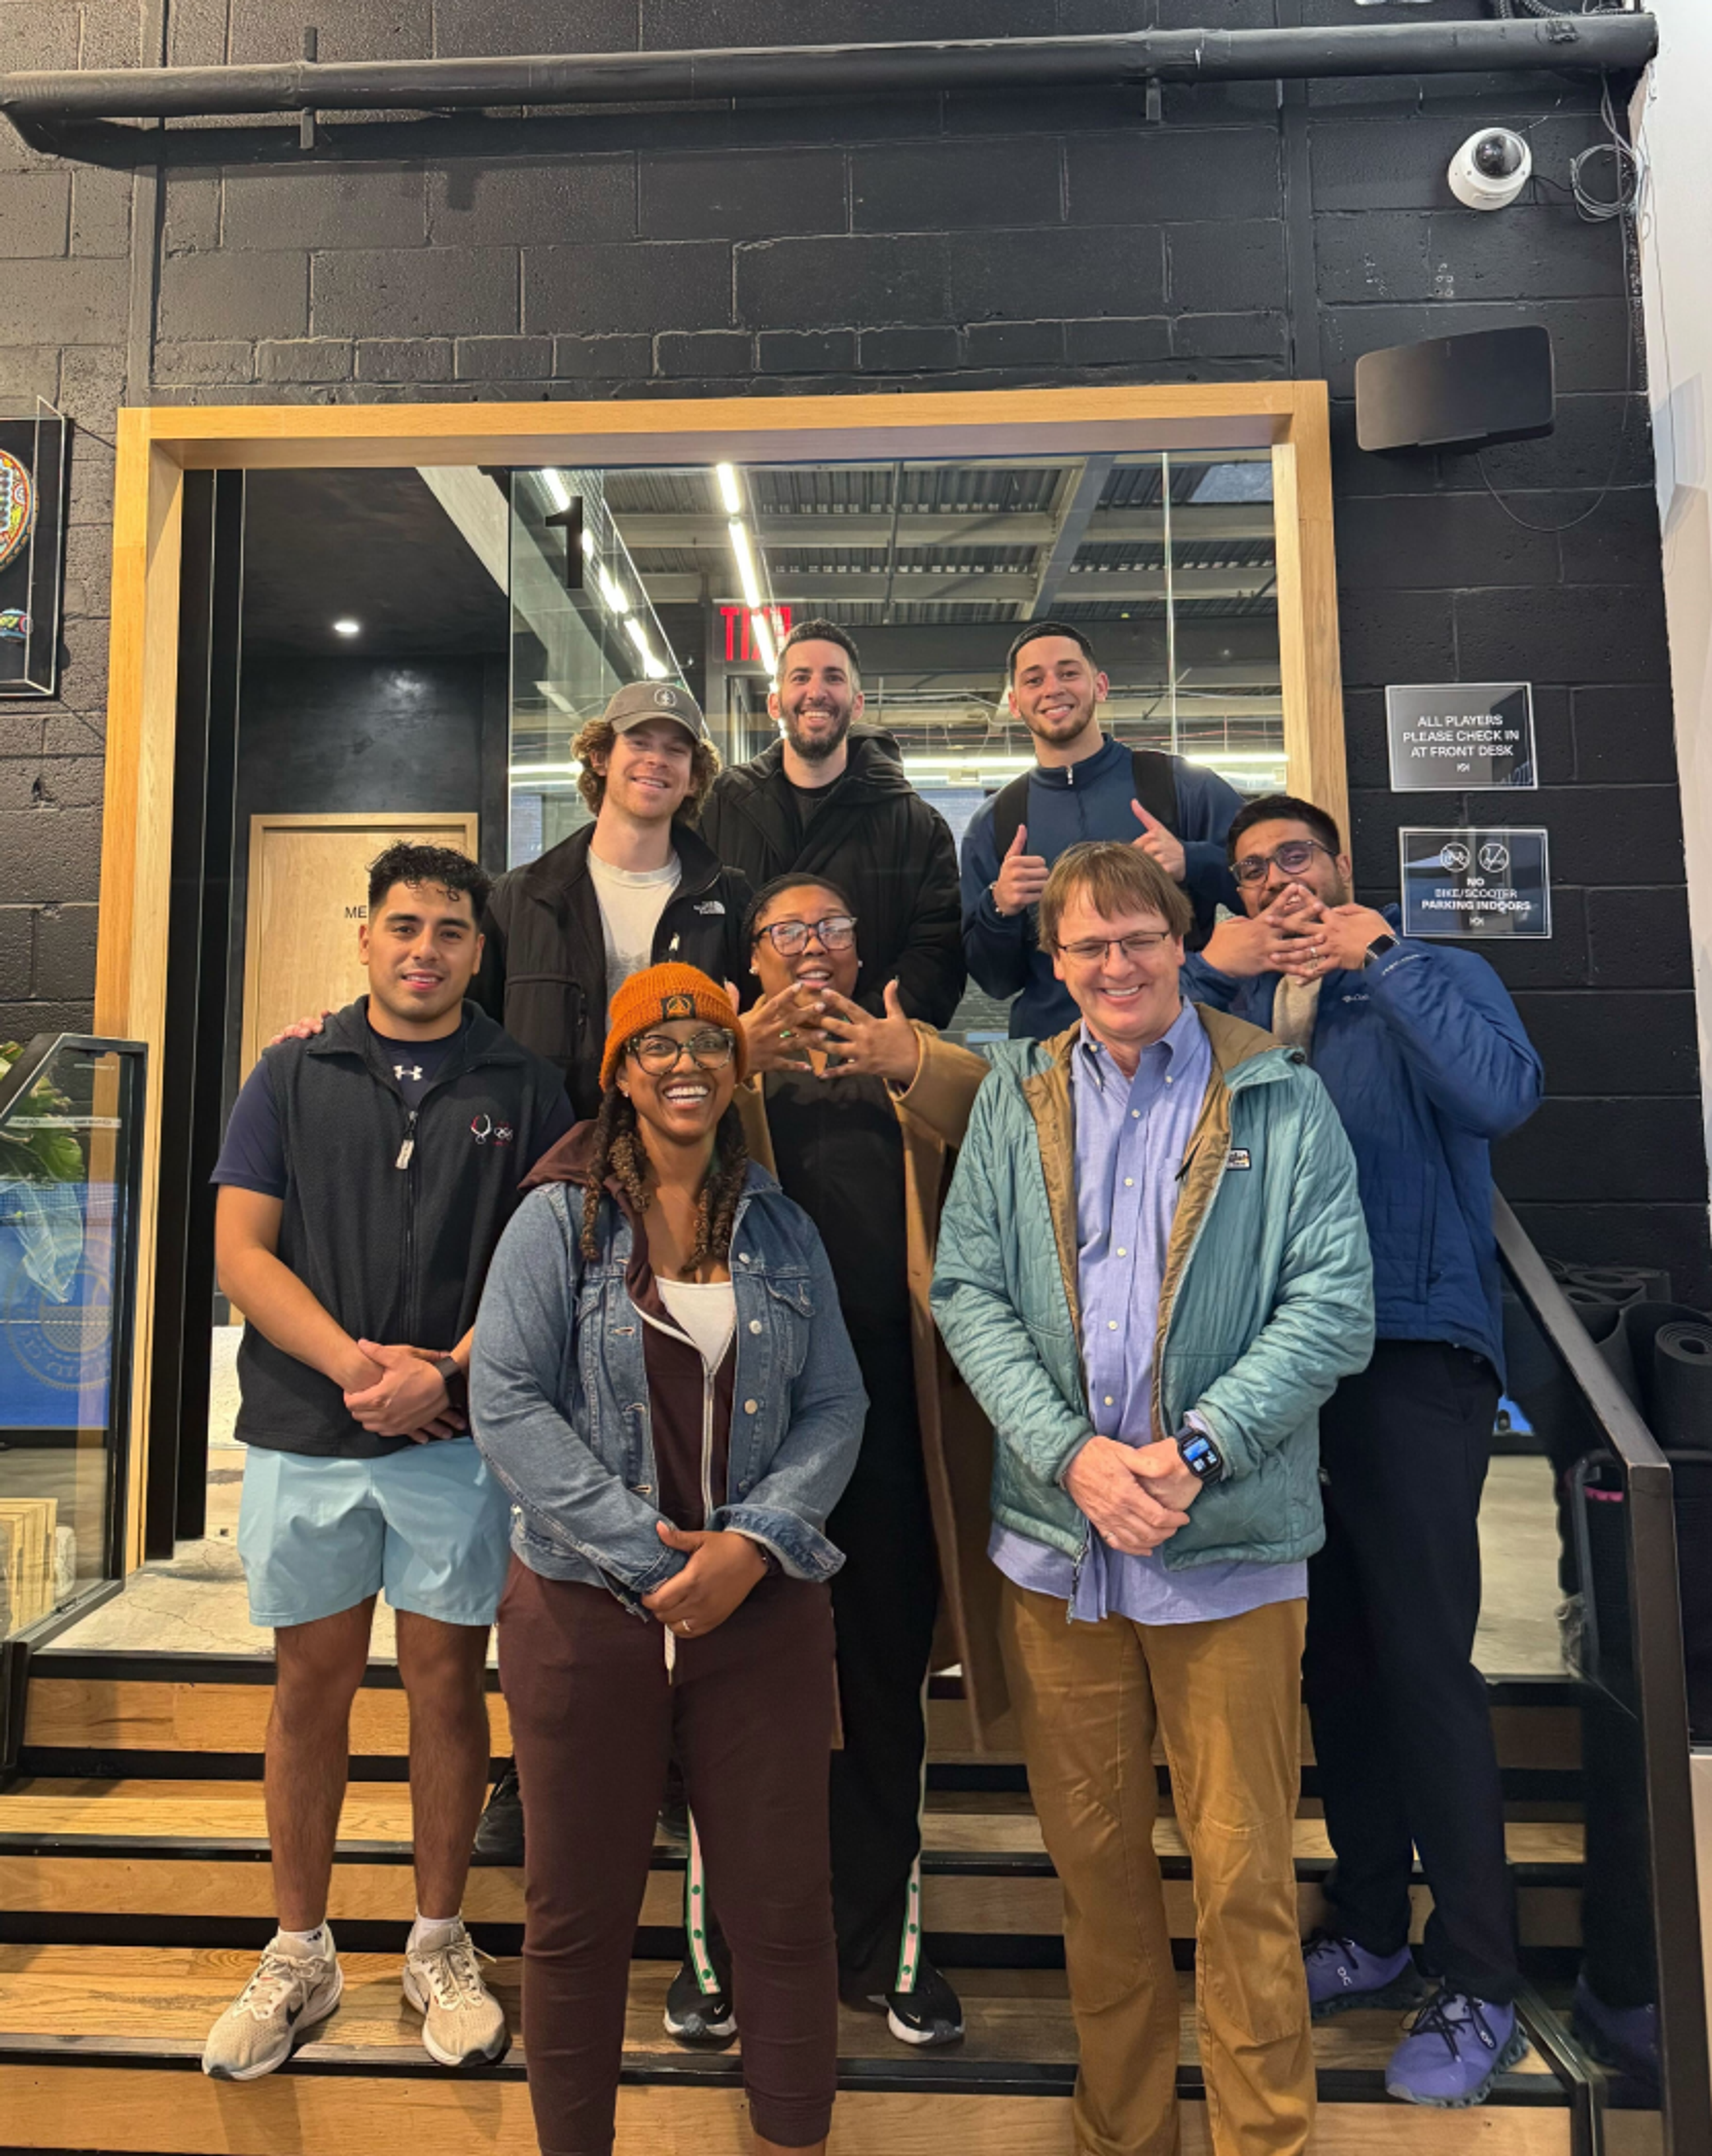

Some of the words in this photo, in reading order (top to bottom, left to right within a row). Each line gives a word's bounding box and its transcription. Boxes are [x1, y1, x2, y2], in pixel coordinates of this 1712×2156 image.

[1417, 715, 1443, 727] ALL
[1445, 715, 1503, 726] PLAYERS
[1403, 731, 1453, 742] PLEASE
[1456, 730, 1502, 741] CHECK
[1504, 730, 1519, 740] IN
[1411, 746, 1428, 757] AT
[1430, 745, 1475, 757] FRONT
[1478, 744, 1514, 756] DESK
[1467, 878, 1485, 887] NO
[1434, 888, 1517, 898] BIKE/SCOOTER
[345, 905, 367, 918] ME
[1421, 900, 1474, 910] PARKING
[1477, 900, 1531, 911] INDOORS
